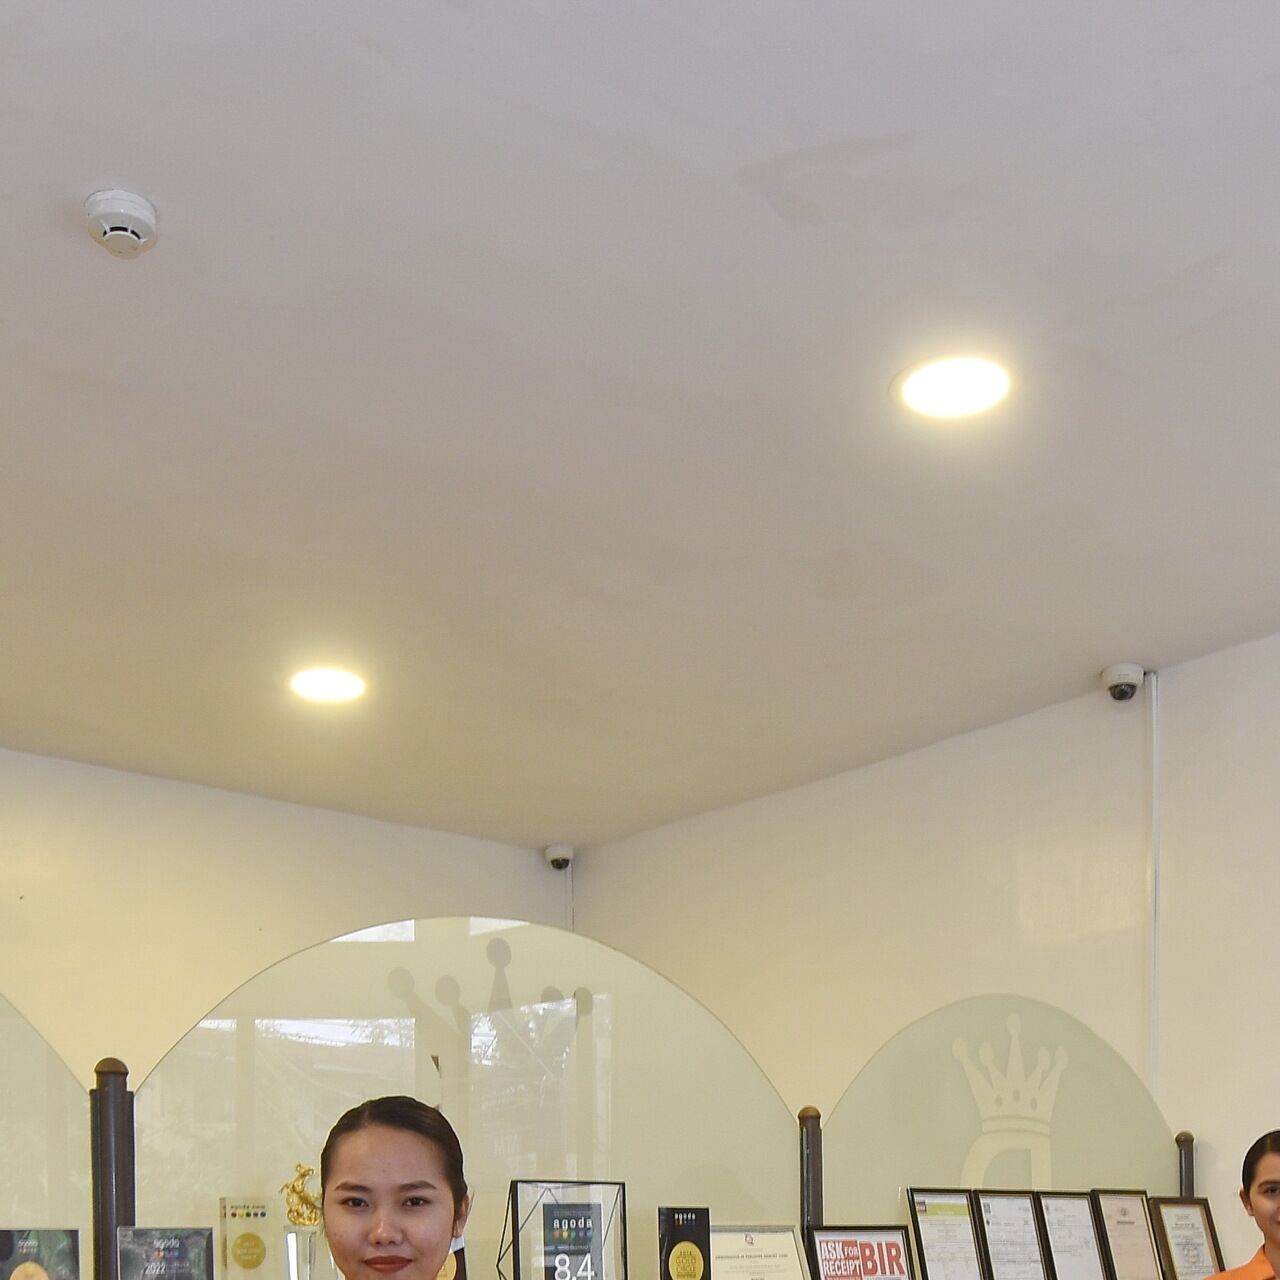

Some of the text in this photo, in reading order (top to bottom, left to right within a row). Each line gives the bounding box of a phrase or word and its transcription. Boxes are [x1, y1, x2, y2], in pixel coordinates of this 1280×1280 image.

[553, 1217, 593, 1230] agoda
[821, 1241, 859, 1259] ASK FOR
[860, 1242, 906, 1276] BIR
[823, 1260, 860, 1276] RECEIPT
